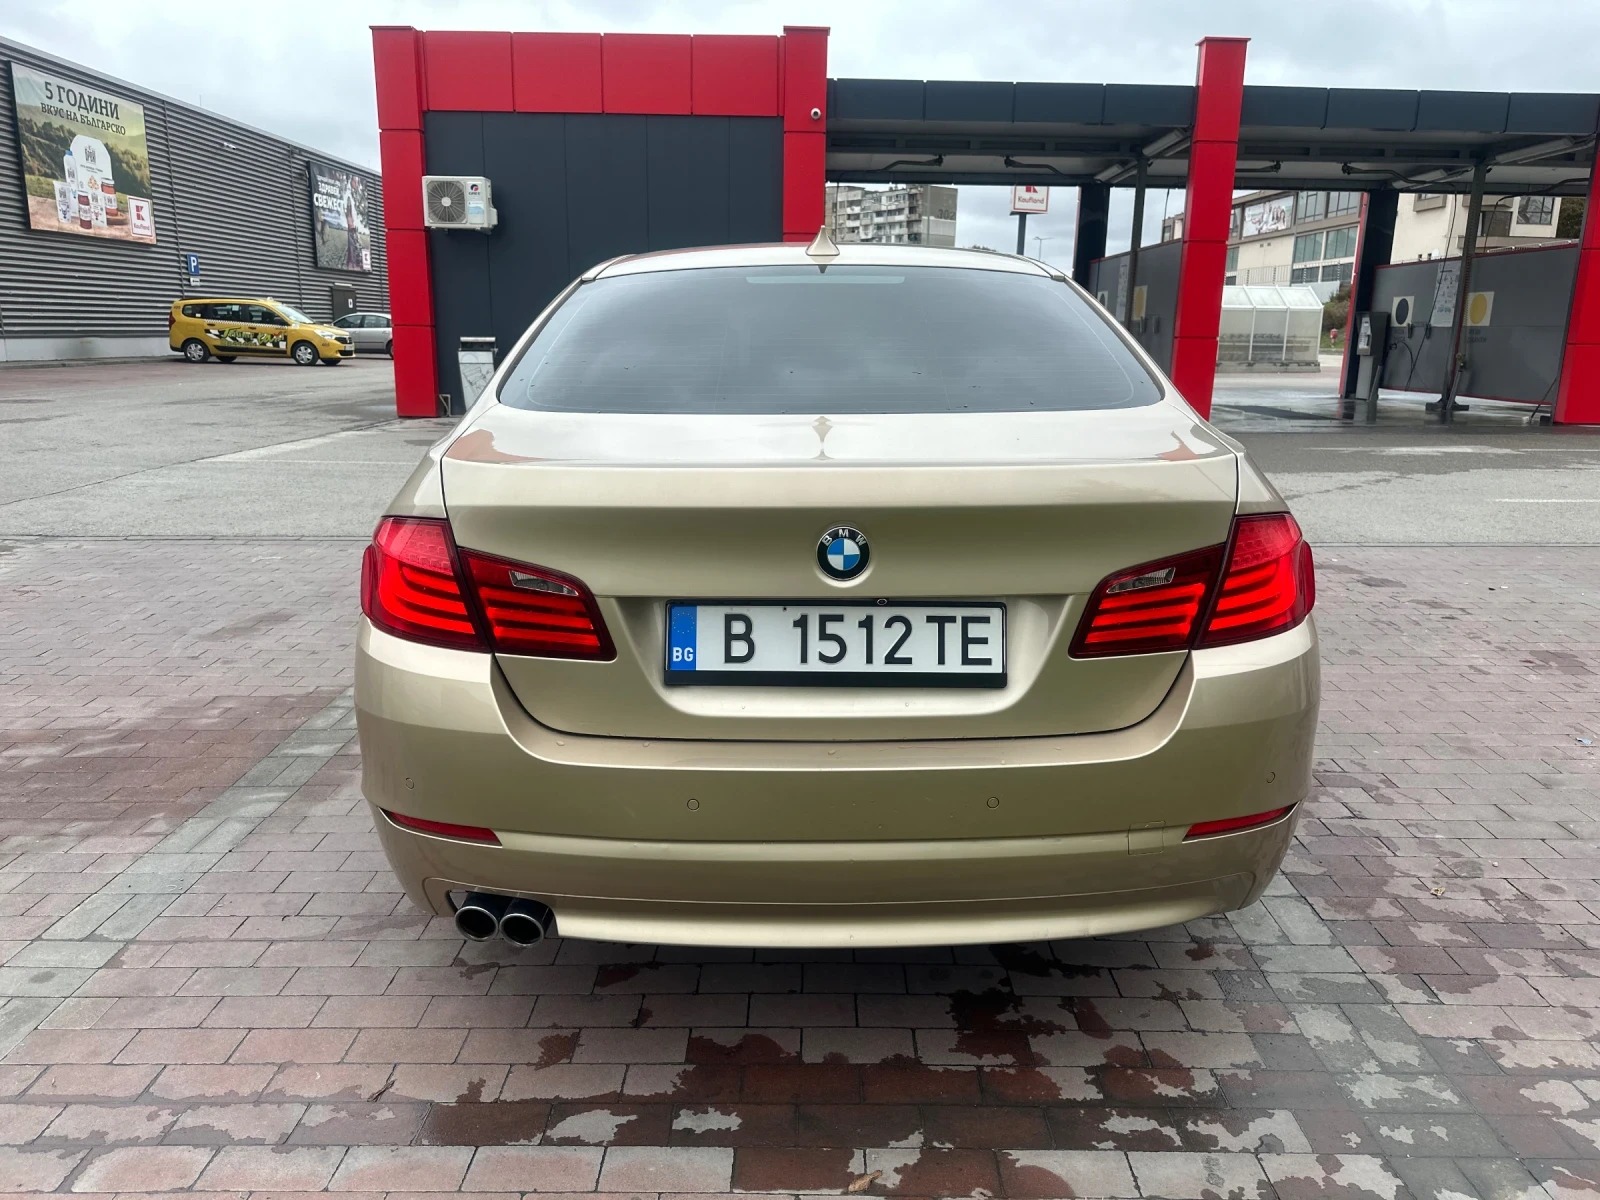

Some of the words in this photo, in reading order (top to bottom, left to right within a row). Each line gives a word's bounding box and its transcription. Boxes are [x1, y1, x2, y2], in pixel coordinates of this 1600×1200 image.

[45, 81, 54, 100] 5
[56, 85, 120, 120] ГОДИНИ
[41, 102, 65, 118] ВКУС
[66, 110, 79, 122] НА
[80, 114, 126, 135] БЪЛГАРСКО
[1018, 196, 1045, 204] Kaufland
[937, 208, 957, 220] 302
[190, 256, 197, 272] P
[821, 528, 867, 547] BMW
[724, 614, 755, 664] B
[792, 614, 912, 664] 1512
[926, 615, 993, 666] TE
[672, 647, 694, 662] BG
